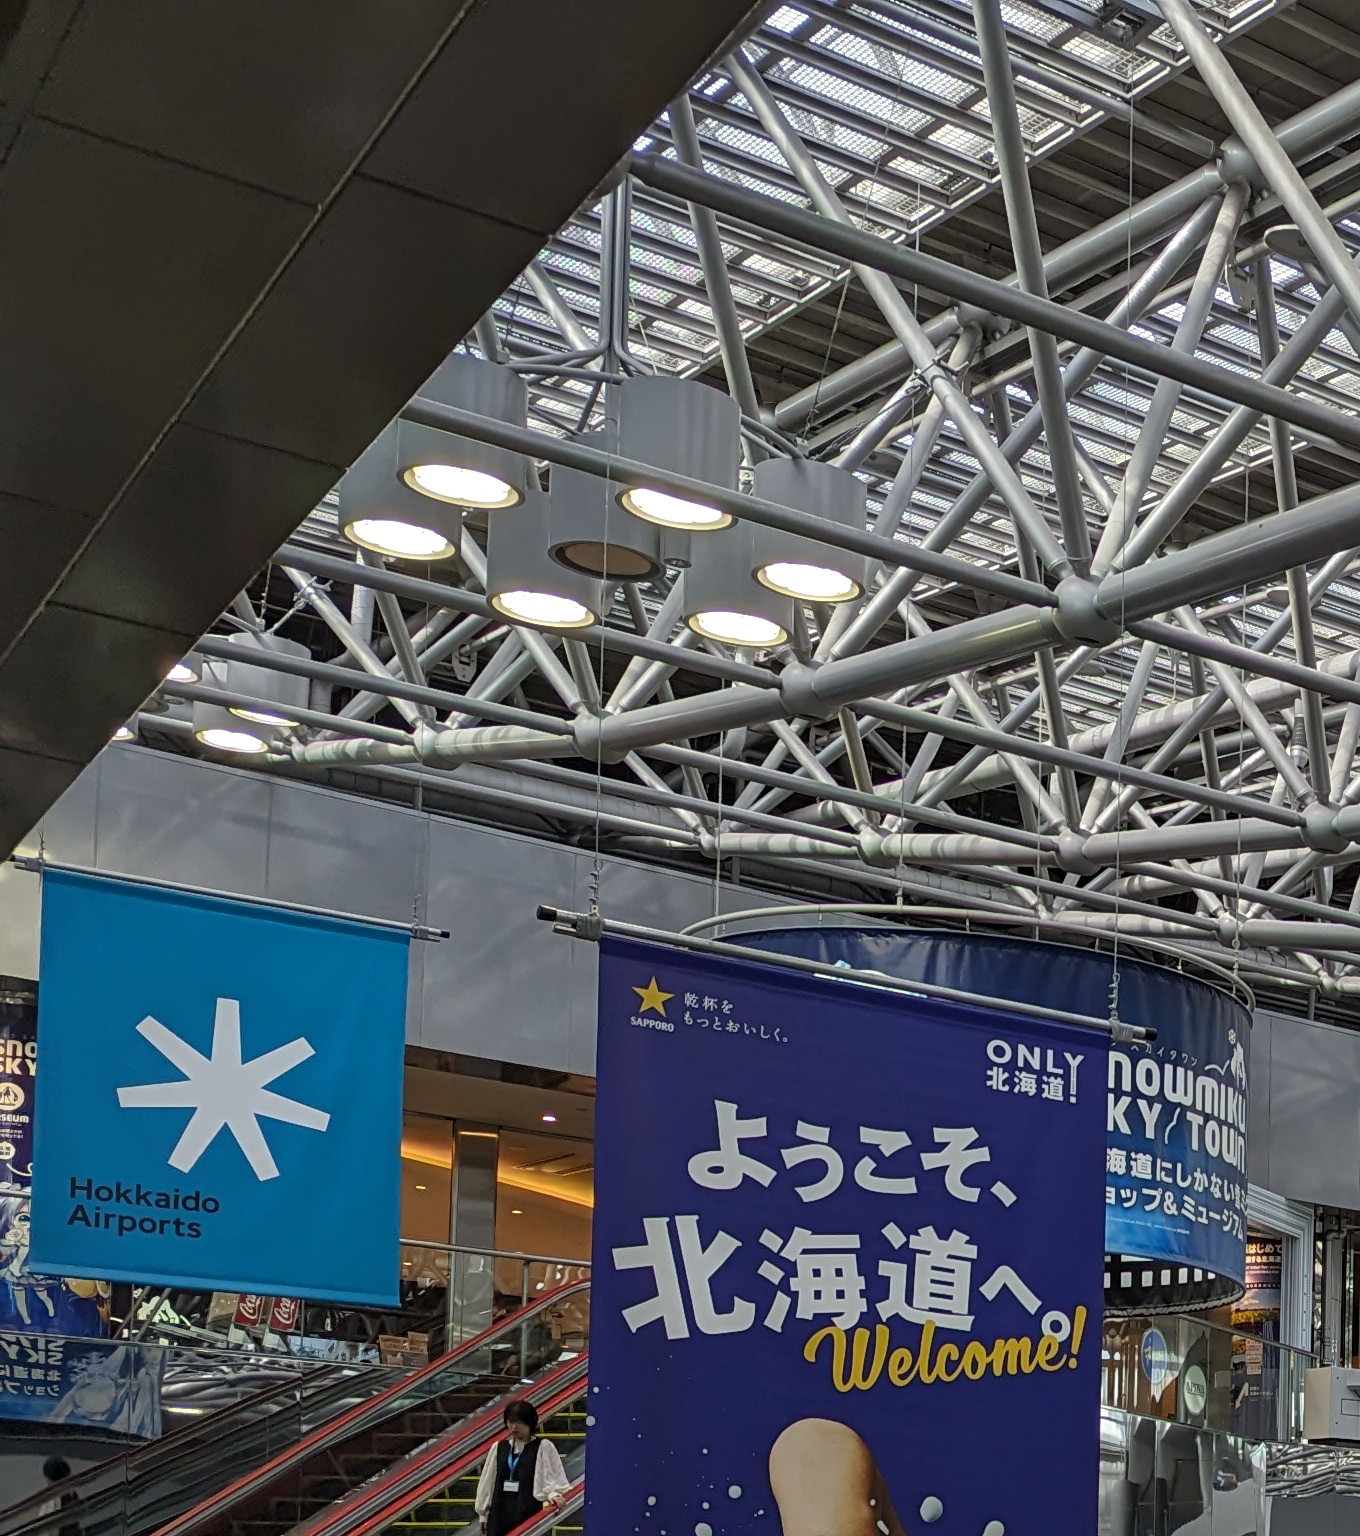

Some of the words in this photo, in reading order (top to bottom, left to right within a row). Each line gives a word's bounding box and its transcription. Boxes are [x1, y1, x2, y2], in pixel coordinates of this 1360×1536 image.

[684, 992, 733, 1014] 乾杯を
[630, 1016, 675, 1033] SAPPORO
[687, 1100, 1017, 1207] ようこそ、
[69, 1175, 221, 1214] Hokkaido
[66, 1203, 203, 1241] Airports
[613, 1215, 1071, 1342] 北海道へ。
[805, 1305, 1088, 1392] Welcome!
